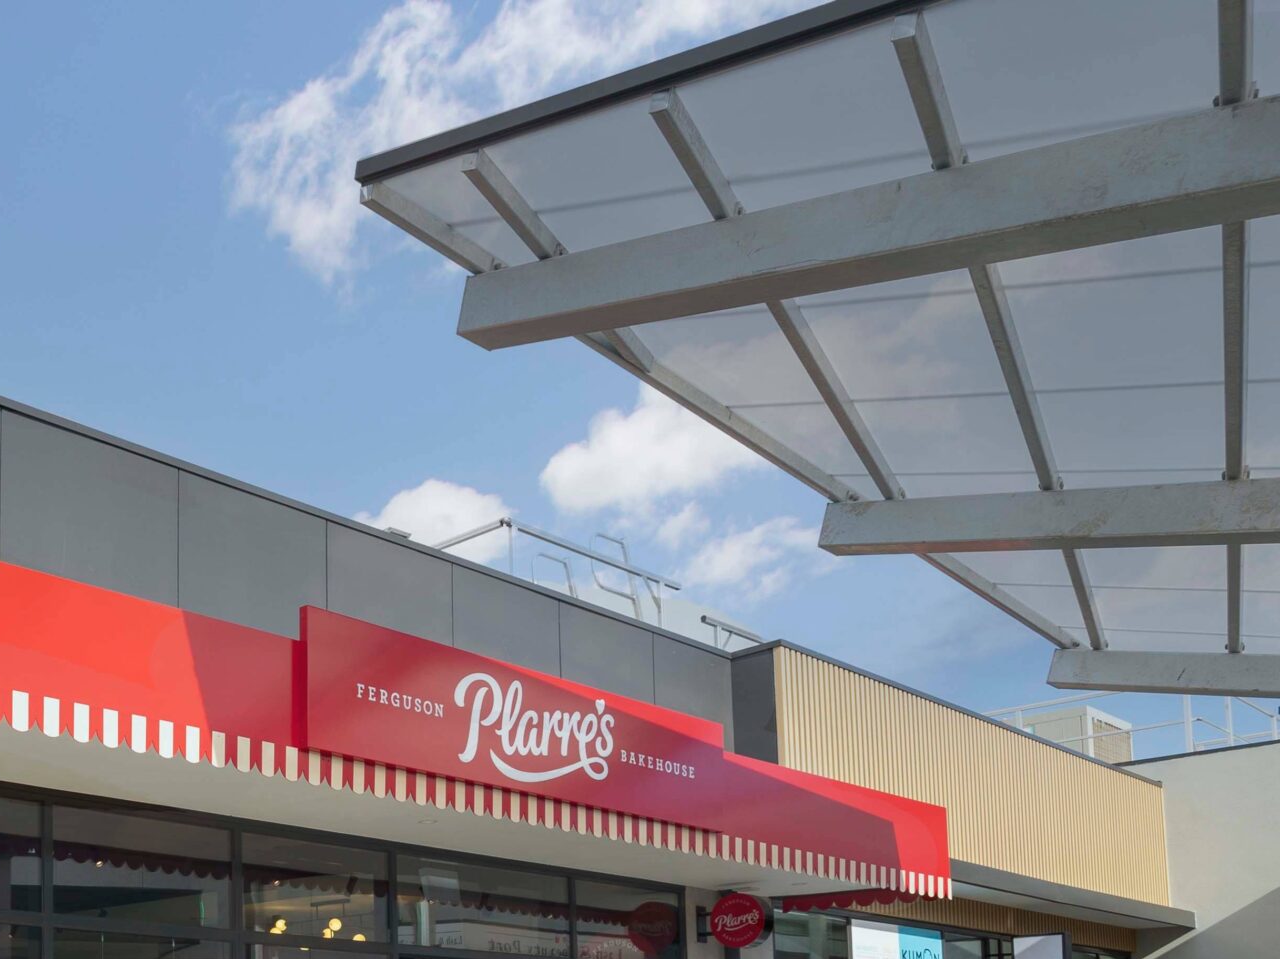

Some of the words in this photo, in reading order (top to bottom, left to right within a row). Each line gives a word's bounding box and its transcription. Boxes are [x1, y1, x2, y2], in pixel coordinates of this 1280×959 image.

[356, 682, 445, 719] FERGUSON
[453, 671, 615, 783] Plarre's
[620, 749, 696, 779] BAKEHOUSE
[714, 908, 760, 932] Plarre's
